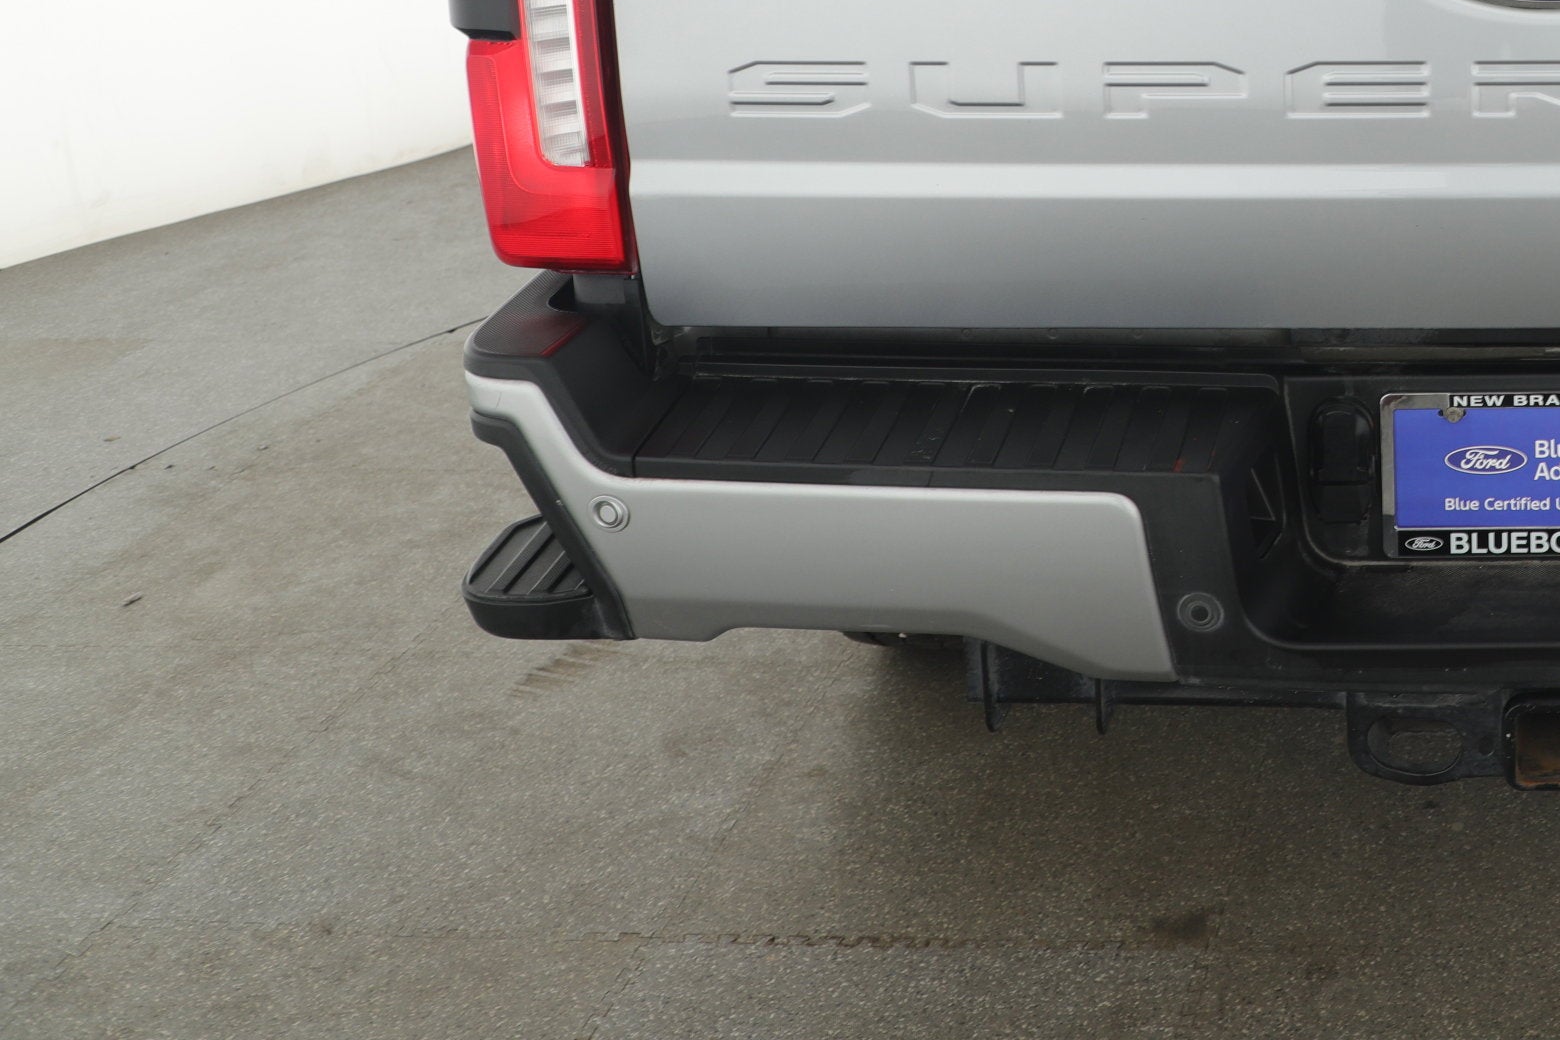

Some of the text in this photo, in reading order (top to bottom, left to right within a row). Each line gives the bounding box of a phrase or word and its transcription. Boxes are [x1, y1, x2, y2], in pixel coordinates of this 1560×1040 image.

[1453, 395, 1505, 408] NEW
[1460, 446, 1512, 470] Ford
[1444, 497, 1480, 512] Blue
[1484, 496, 1551, 511] Certified
[1412, 537, 1437, 549] Ford
